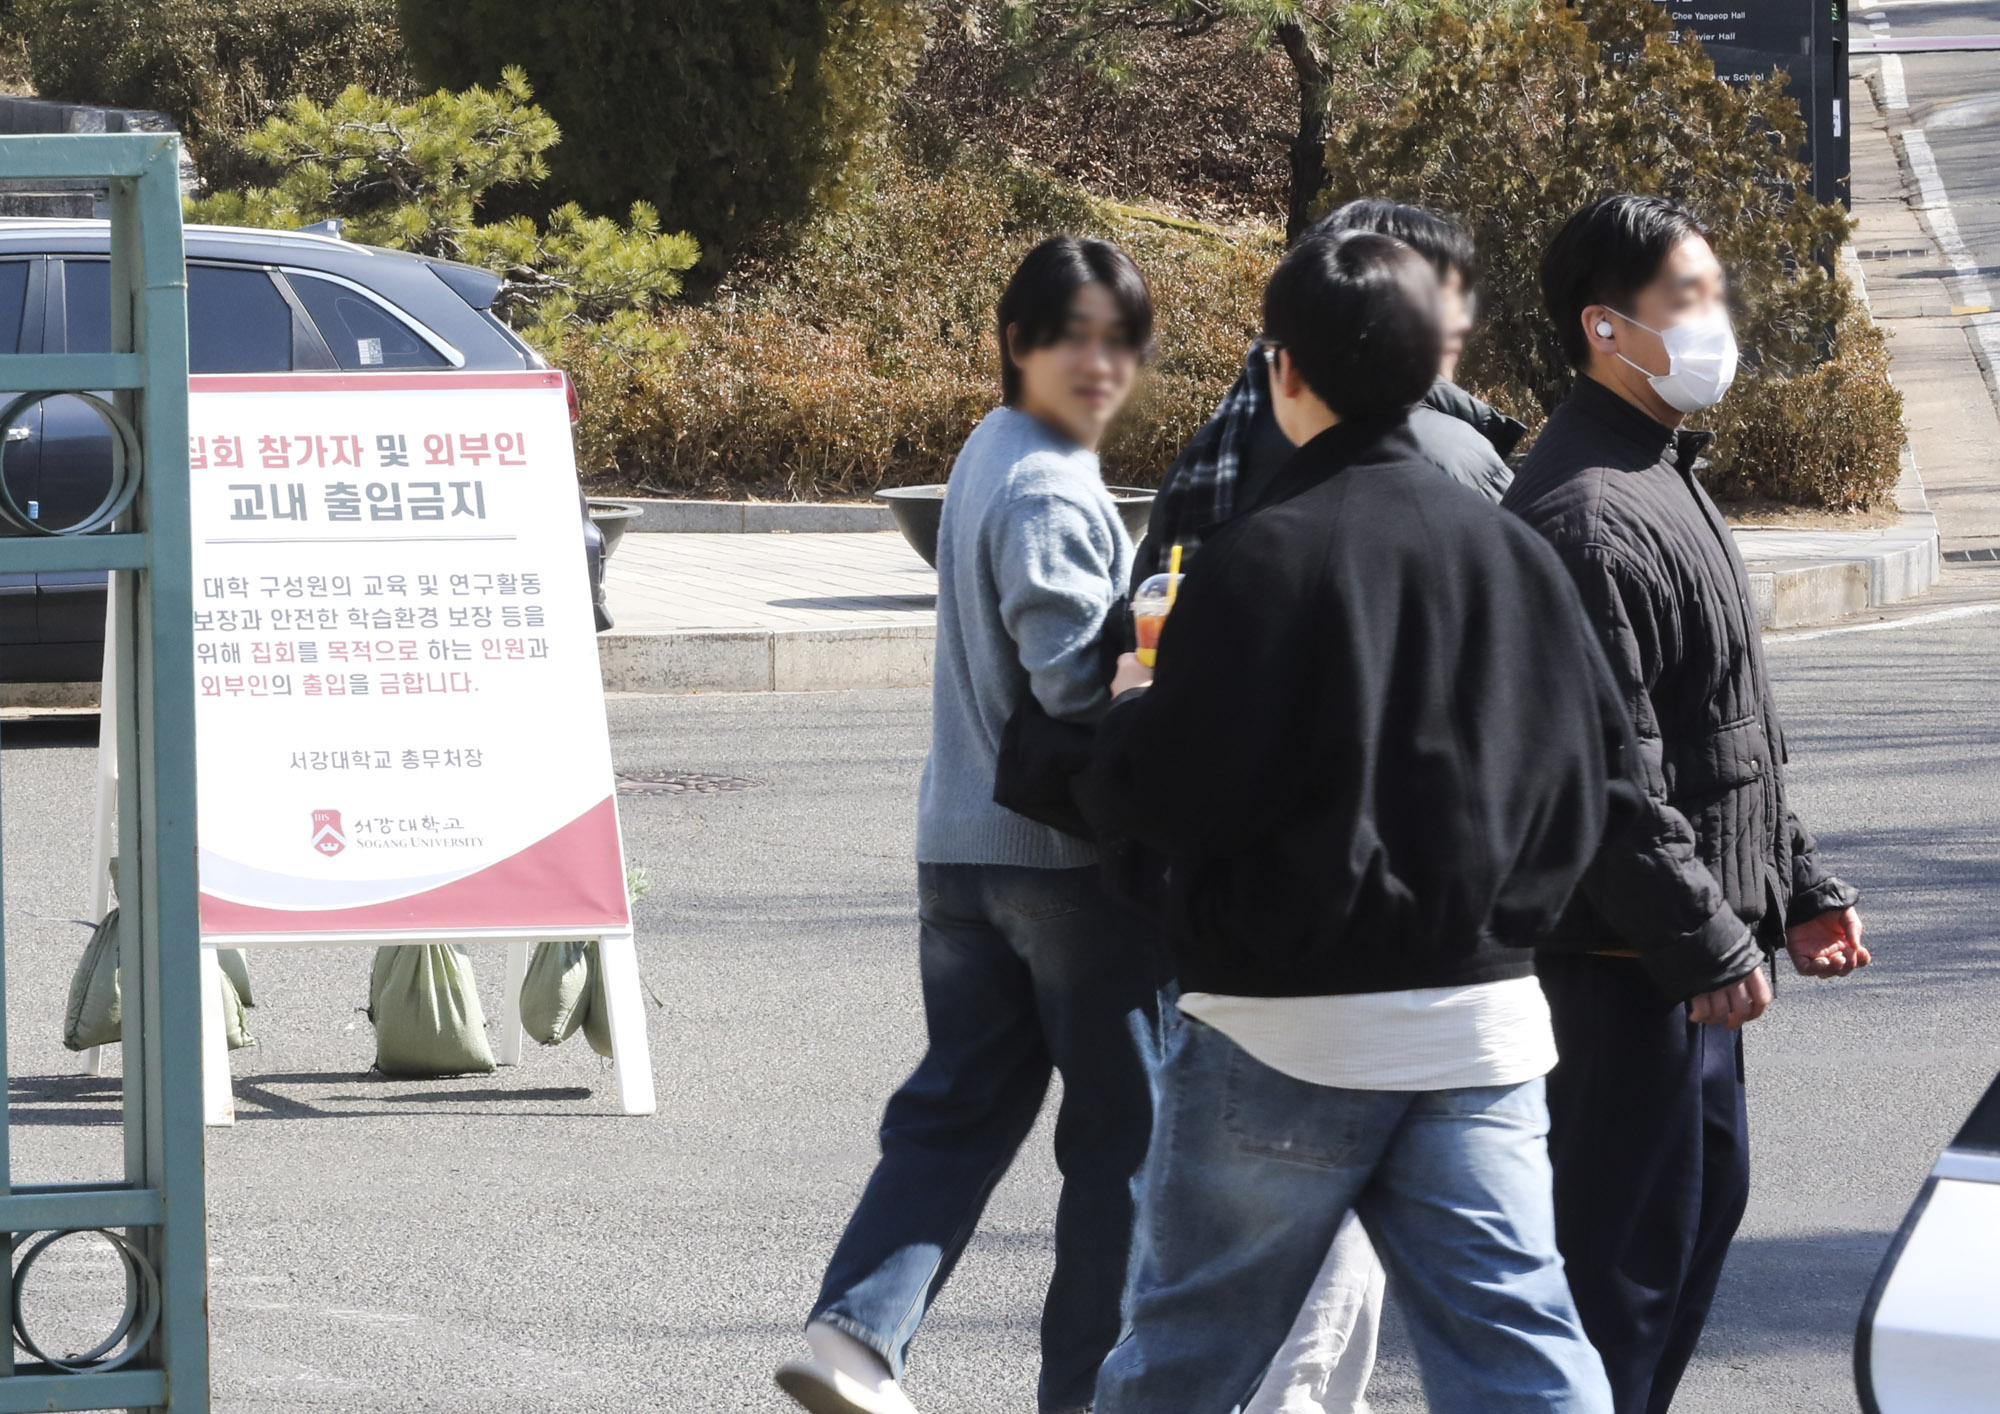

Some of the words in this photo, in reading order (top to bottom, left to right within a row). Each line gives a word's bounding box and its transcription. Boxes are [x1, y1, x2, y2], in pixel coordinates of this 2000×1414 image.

[1672, 12, 1692, 20] Choe
[1695, 12, 1728, 21] Yangeop
[1731, 11, 1745, 19] Hall
[1719, 32, 1735, 40] Hall
[1733, 73, 1764, 81] Schol
[258, 435, 364, 468] 참가자
[376, 435, 409, 467] 및
[424, 432, 526, 466] 외부인
[229, 483, 307, 521] 교내
[324, 481, 486, 521] 출입금지
[204, 577, 249, 598] 대학
[260, 576, 351, 598] 구성원의
[363, 575, 407, 596] 교육
[418, 575, 438, 596] 및
[450, 573, 540, 595] 연구활동
[194, 608, 262, 632] 보장과
[271, 608, 338, 630] 안전한
[347, 607, 438, 629] 학습환경
[449, 607, 492, 628] 보장
[502, 606, 544, 627] 등을
[198, 642, 240, 664] 위해
[251, 642, 318, 663] 집회를
[328, 641, 418, 662] 목적으로
[428, 639, 472, 660] 하는
[482, 638, 549, 659] 인원과
[201, 675, 291, 696] 외부인의
[303, 674, 368, 695] 출입을
[380, 672, 478, 694] 금합니다.
[290, 750, 391, 770] 서강대학교
[402, 749, 482, 769] 총무처장
[355, 816, 464, 834] 서강대학교
